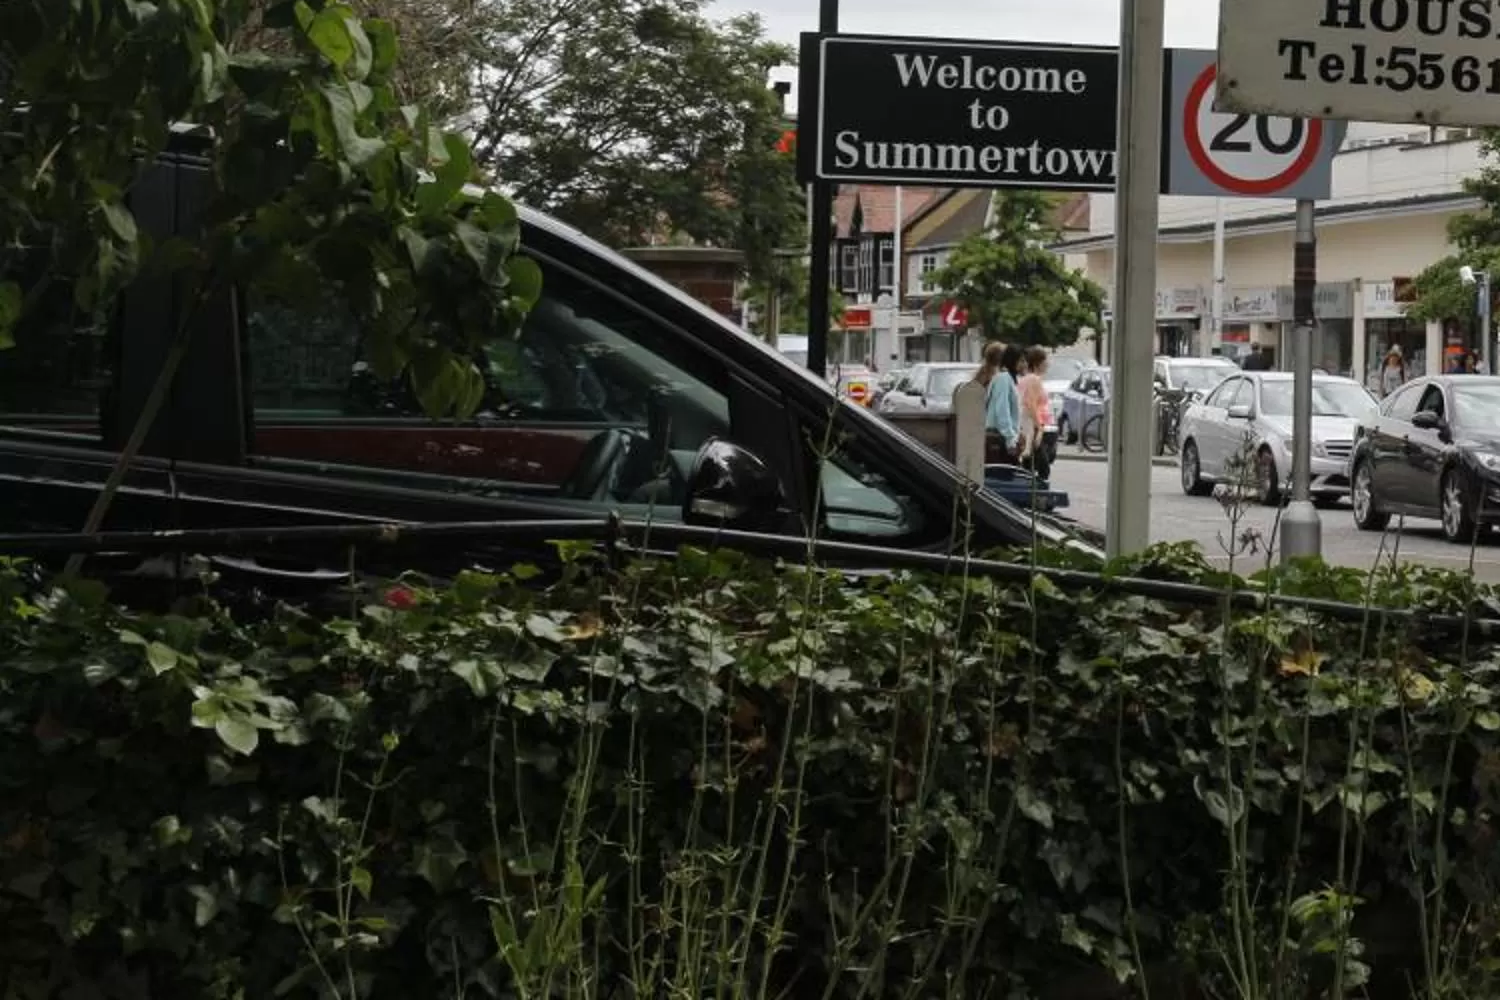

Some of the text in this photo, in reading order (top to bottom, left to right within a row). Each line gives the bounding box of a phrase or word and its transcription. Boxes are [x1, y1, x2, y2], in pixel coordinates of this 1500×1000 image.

[894, 53, 1087, 94] Welcome
[969, 97, 1009, 131] to
[1209, 113, 1304, 154] 20
